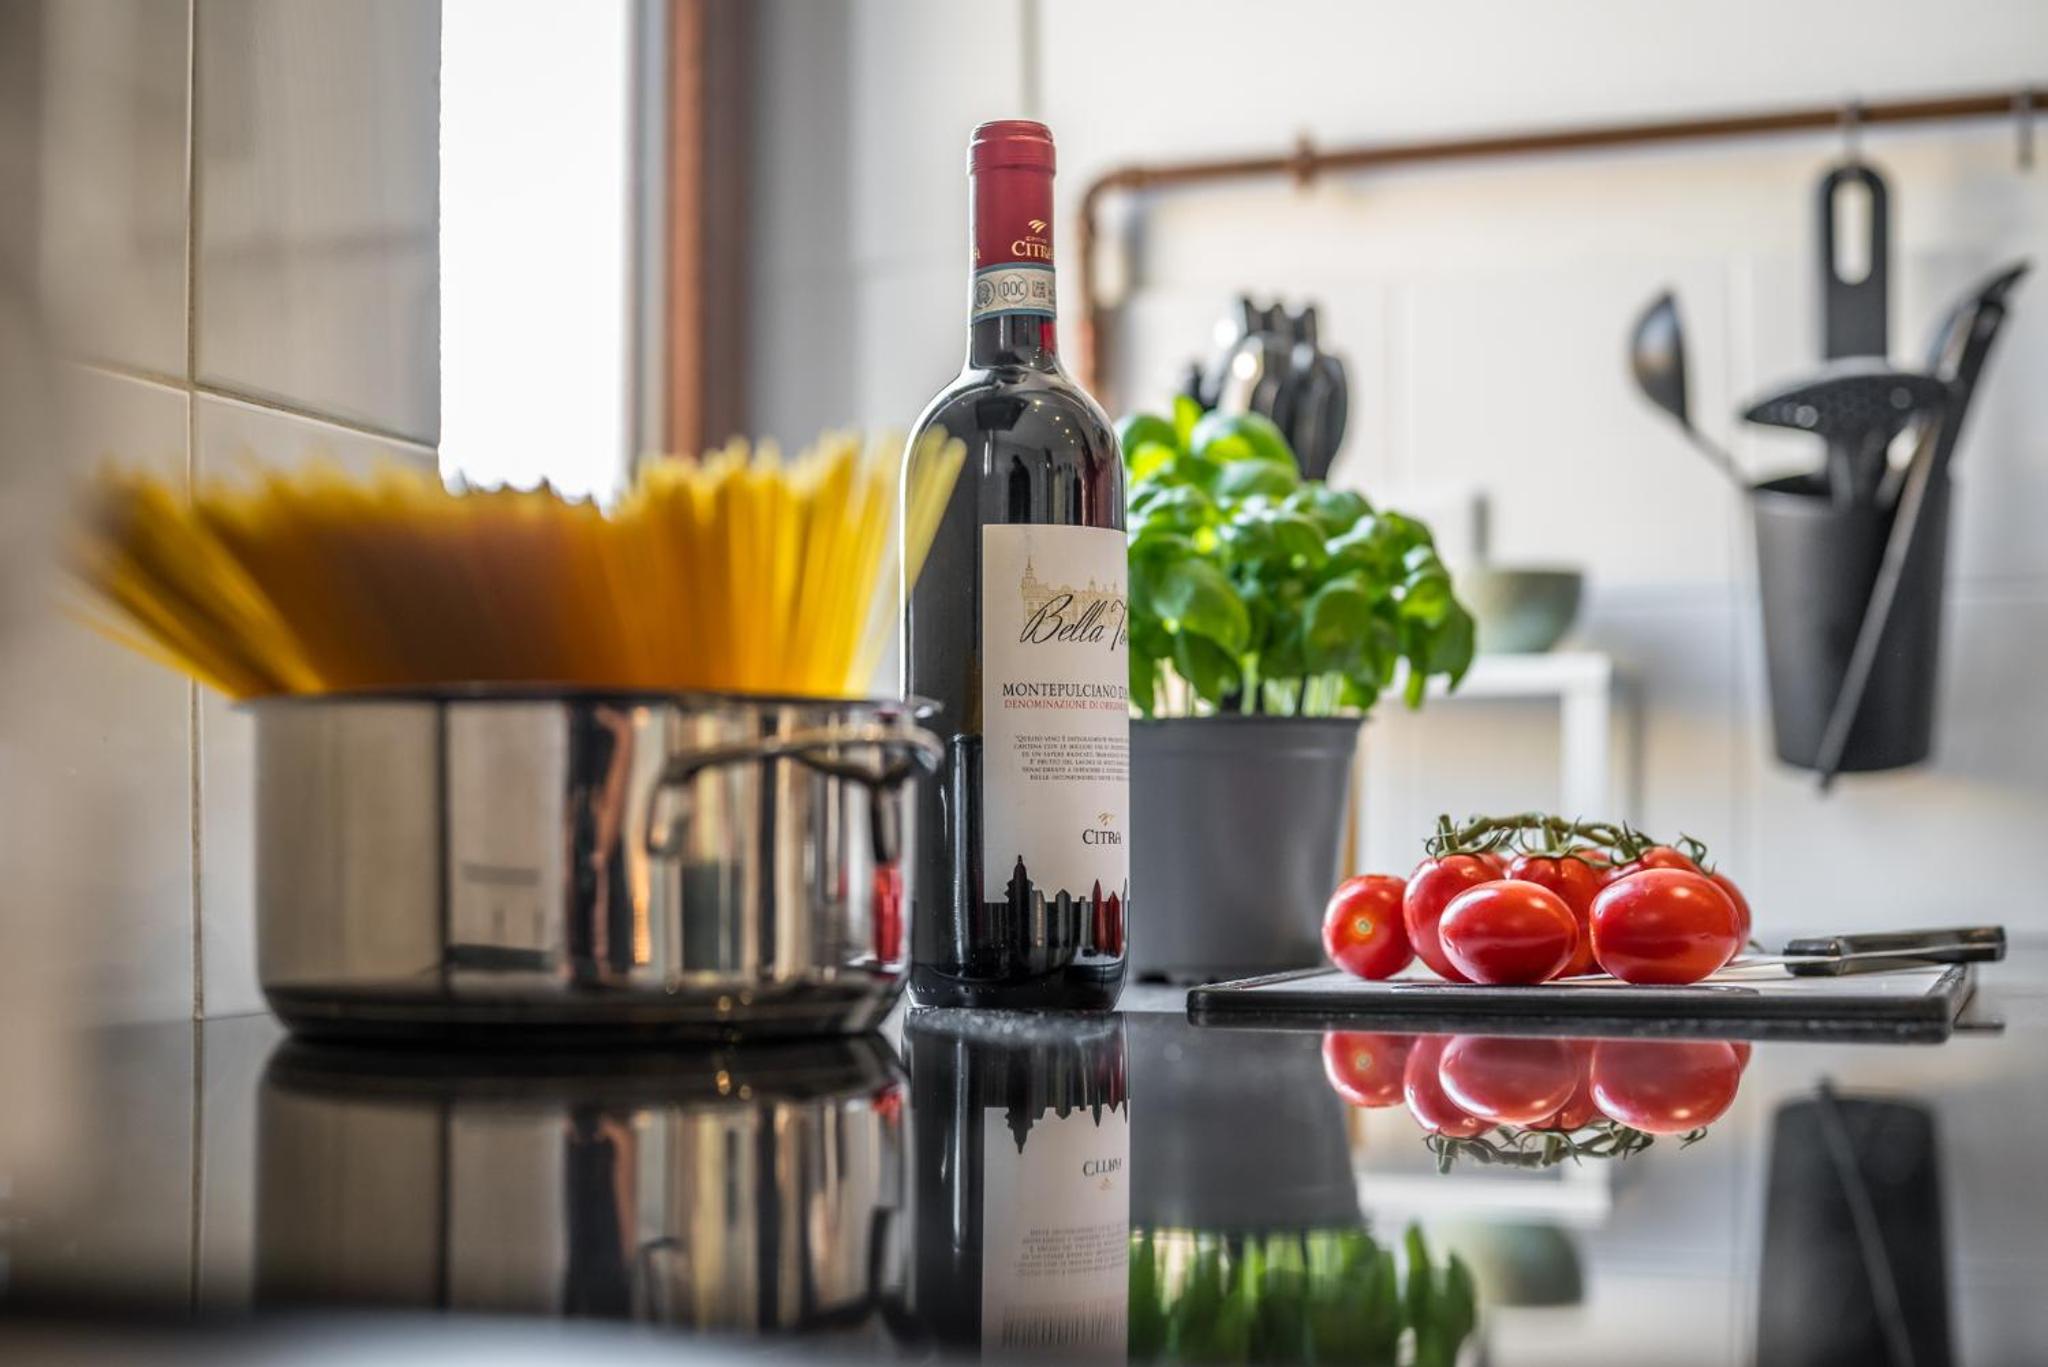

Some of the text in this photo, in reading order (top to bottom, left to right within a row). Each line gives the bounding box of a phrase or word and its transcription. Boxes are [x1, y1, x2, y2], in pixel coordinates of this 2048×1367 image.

[1002, 281, 1025, 297] DOC
[1019, 593, 1108, 644] Bella
[1002, 682, 1118, 699] MONTEPULCIANO
[1004, 699, 1088, 711] DENOMINAZIONE
[1082, 828, 1122, 845] CITRA
